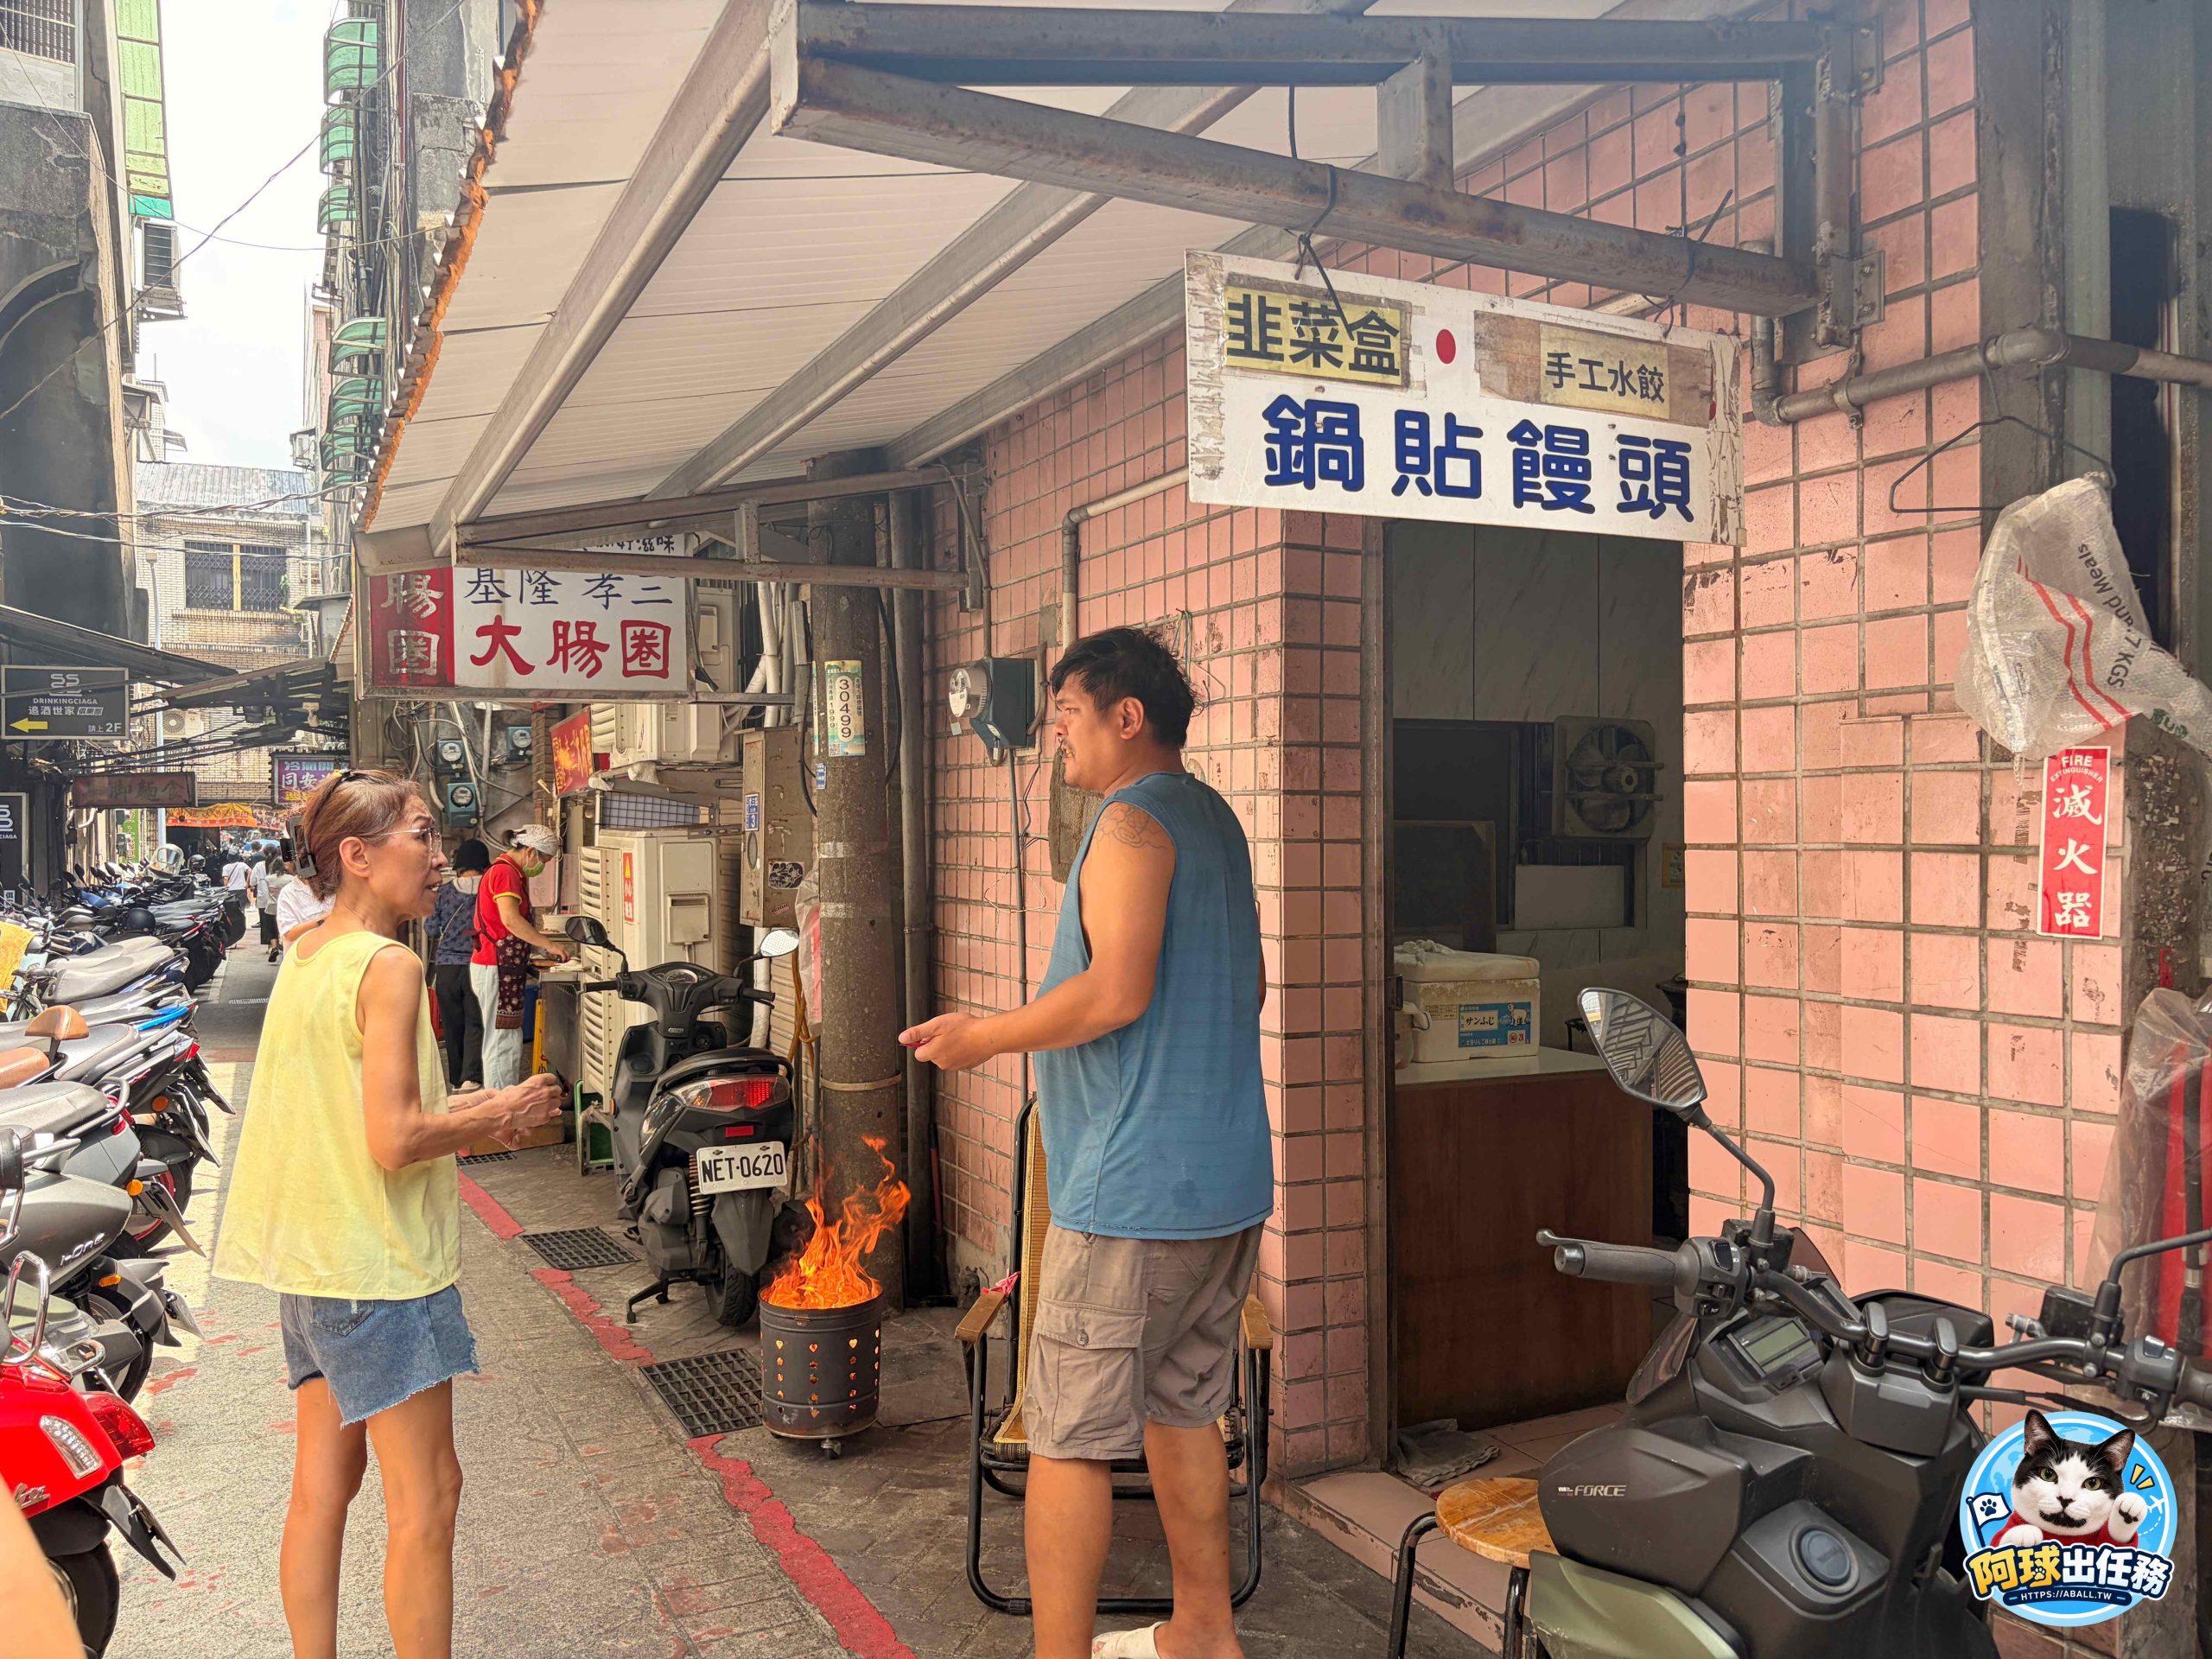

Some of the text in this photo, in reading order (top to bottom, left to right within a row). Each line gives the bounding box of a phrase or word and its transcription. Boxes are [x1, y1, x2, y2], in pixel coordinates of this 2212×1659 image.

[1227, 293, 1401, 377] 韭菜盒
[1545, 352, 1666, 404] 手工水餃
[1262, 394, 1694, 522] 鍋貼饅頭
[2077, 543, 2113, 594] Meals
[470, 614, 671, 679] 大腸圈
[2107, 651, 2135, 688] KGS
[839, 678, 852, 739] 30499
[2050, 766, 2103, 783] EXTINGUISHER
[2061, 754, 2093, 768] FIRE
[2052, 784, 2102, 928] 滅火器
[1465, 1016, 1495, 1027] サンふじ
[701, 1154, 785, 1184] NET-0620
[1574, 1484, 1627, 1497] FORCE
